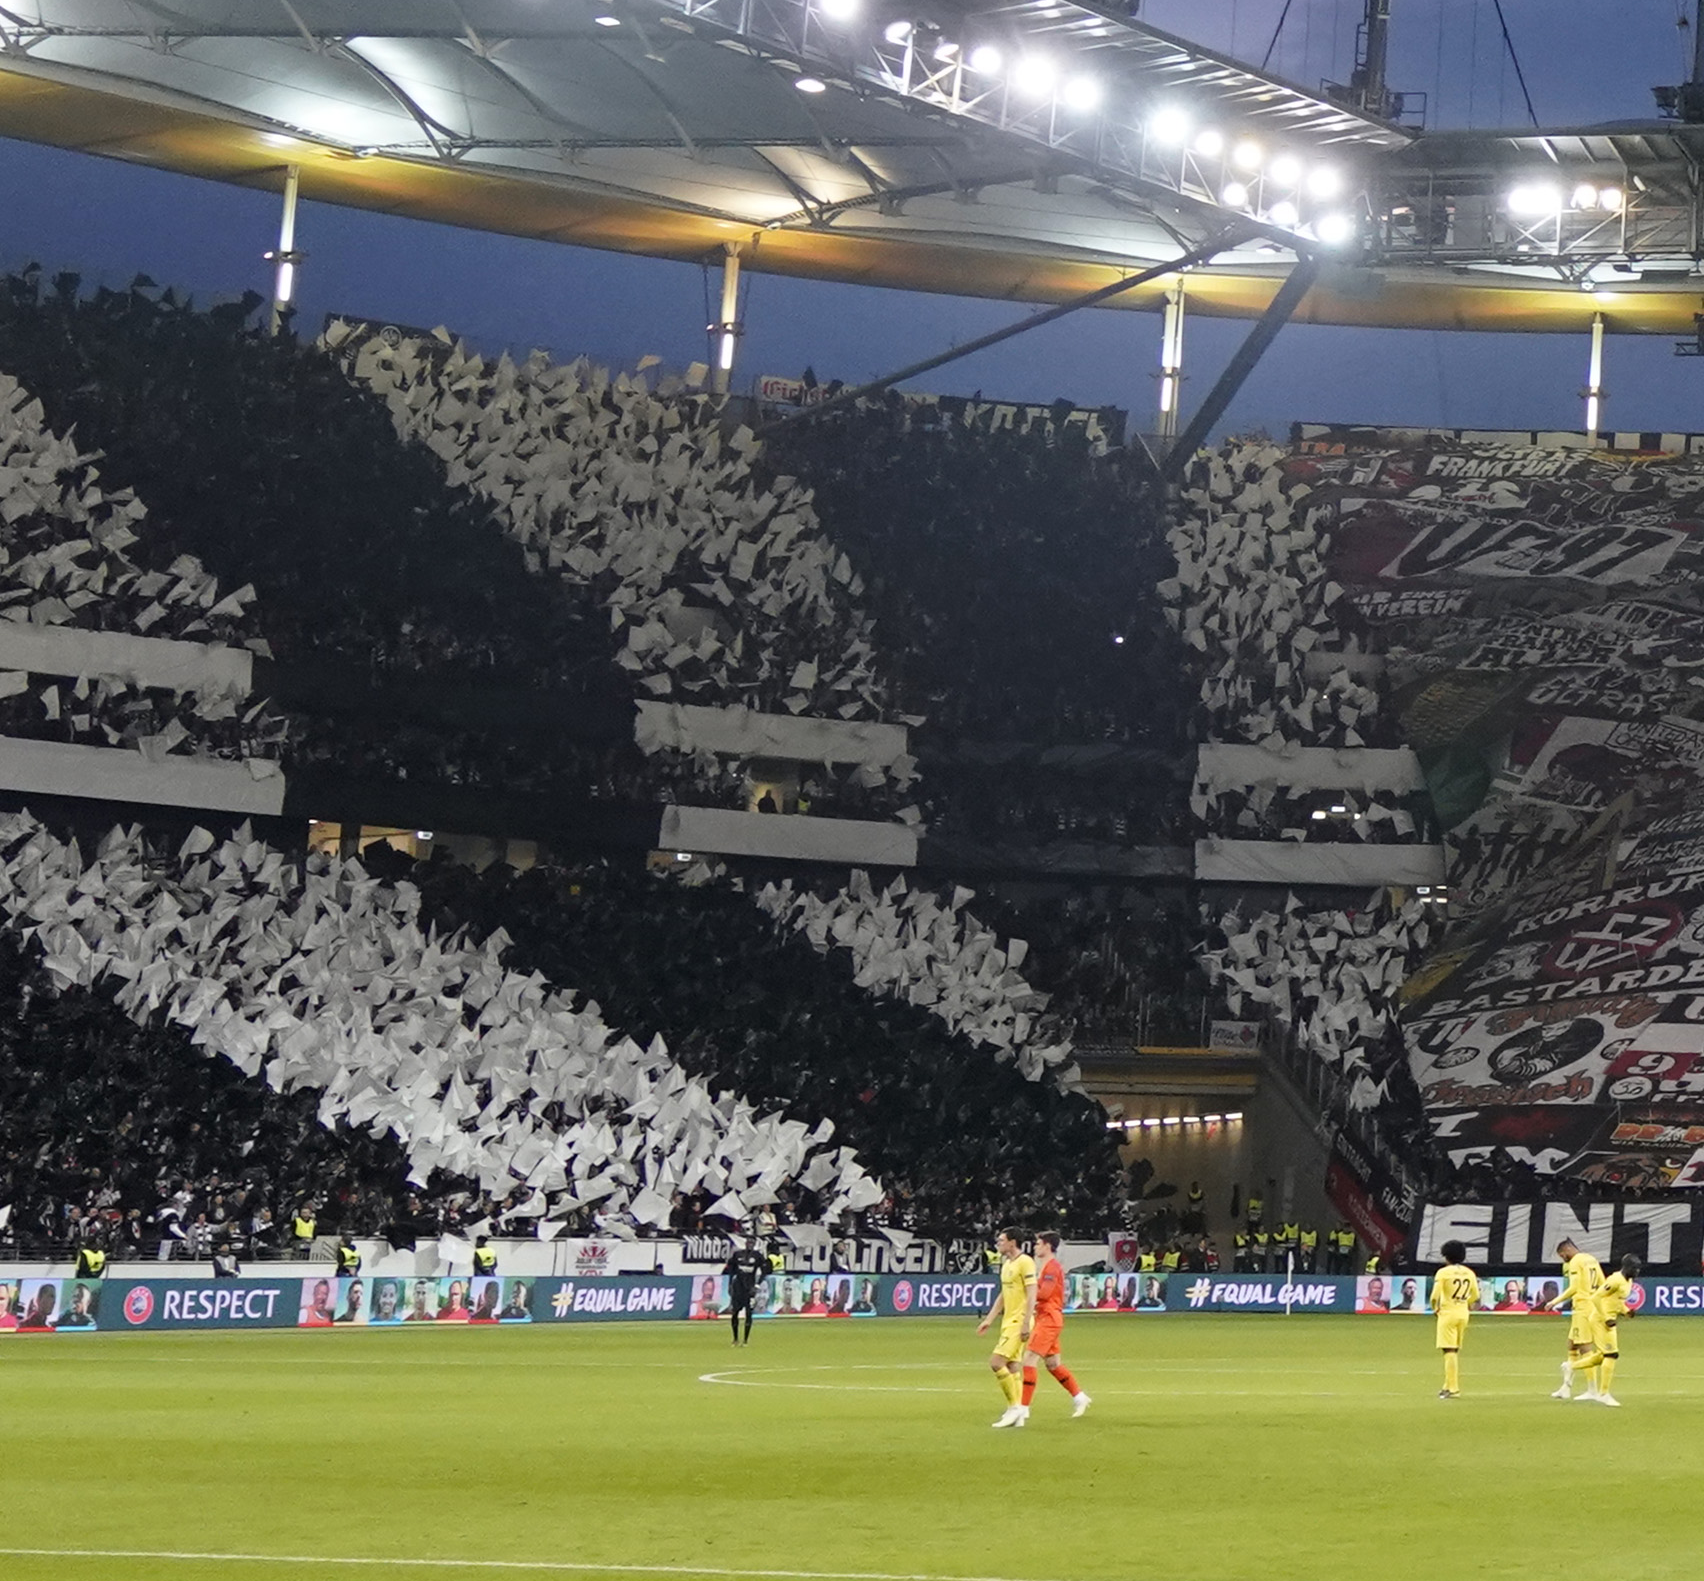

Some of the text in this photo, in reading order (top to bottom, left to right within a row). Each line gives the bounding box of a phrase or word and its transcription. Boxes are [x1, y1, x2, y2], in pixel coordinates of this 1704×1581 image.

[918, 1283, 996, 1307] RESPECT
[1453, 1279, 1471, 1300] 22
[163, 1289, 280, 1320] RESPECT
